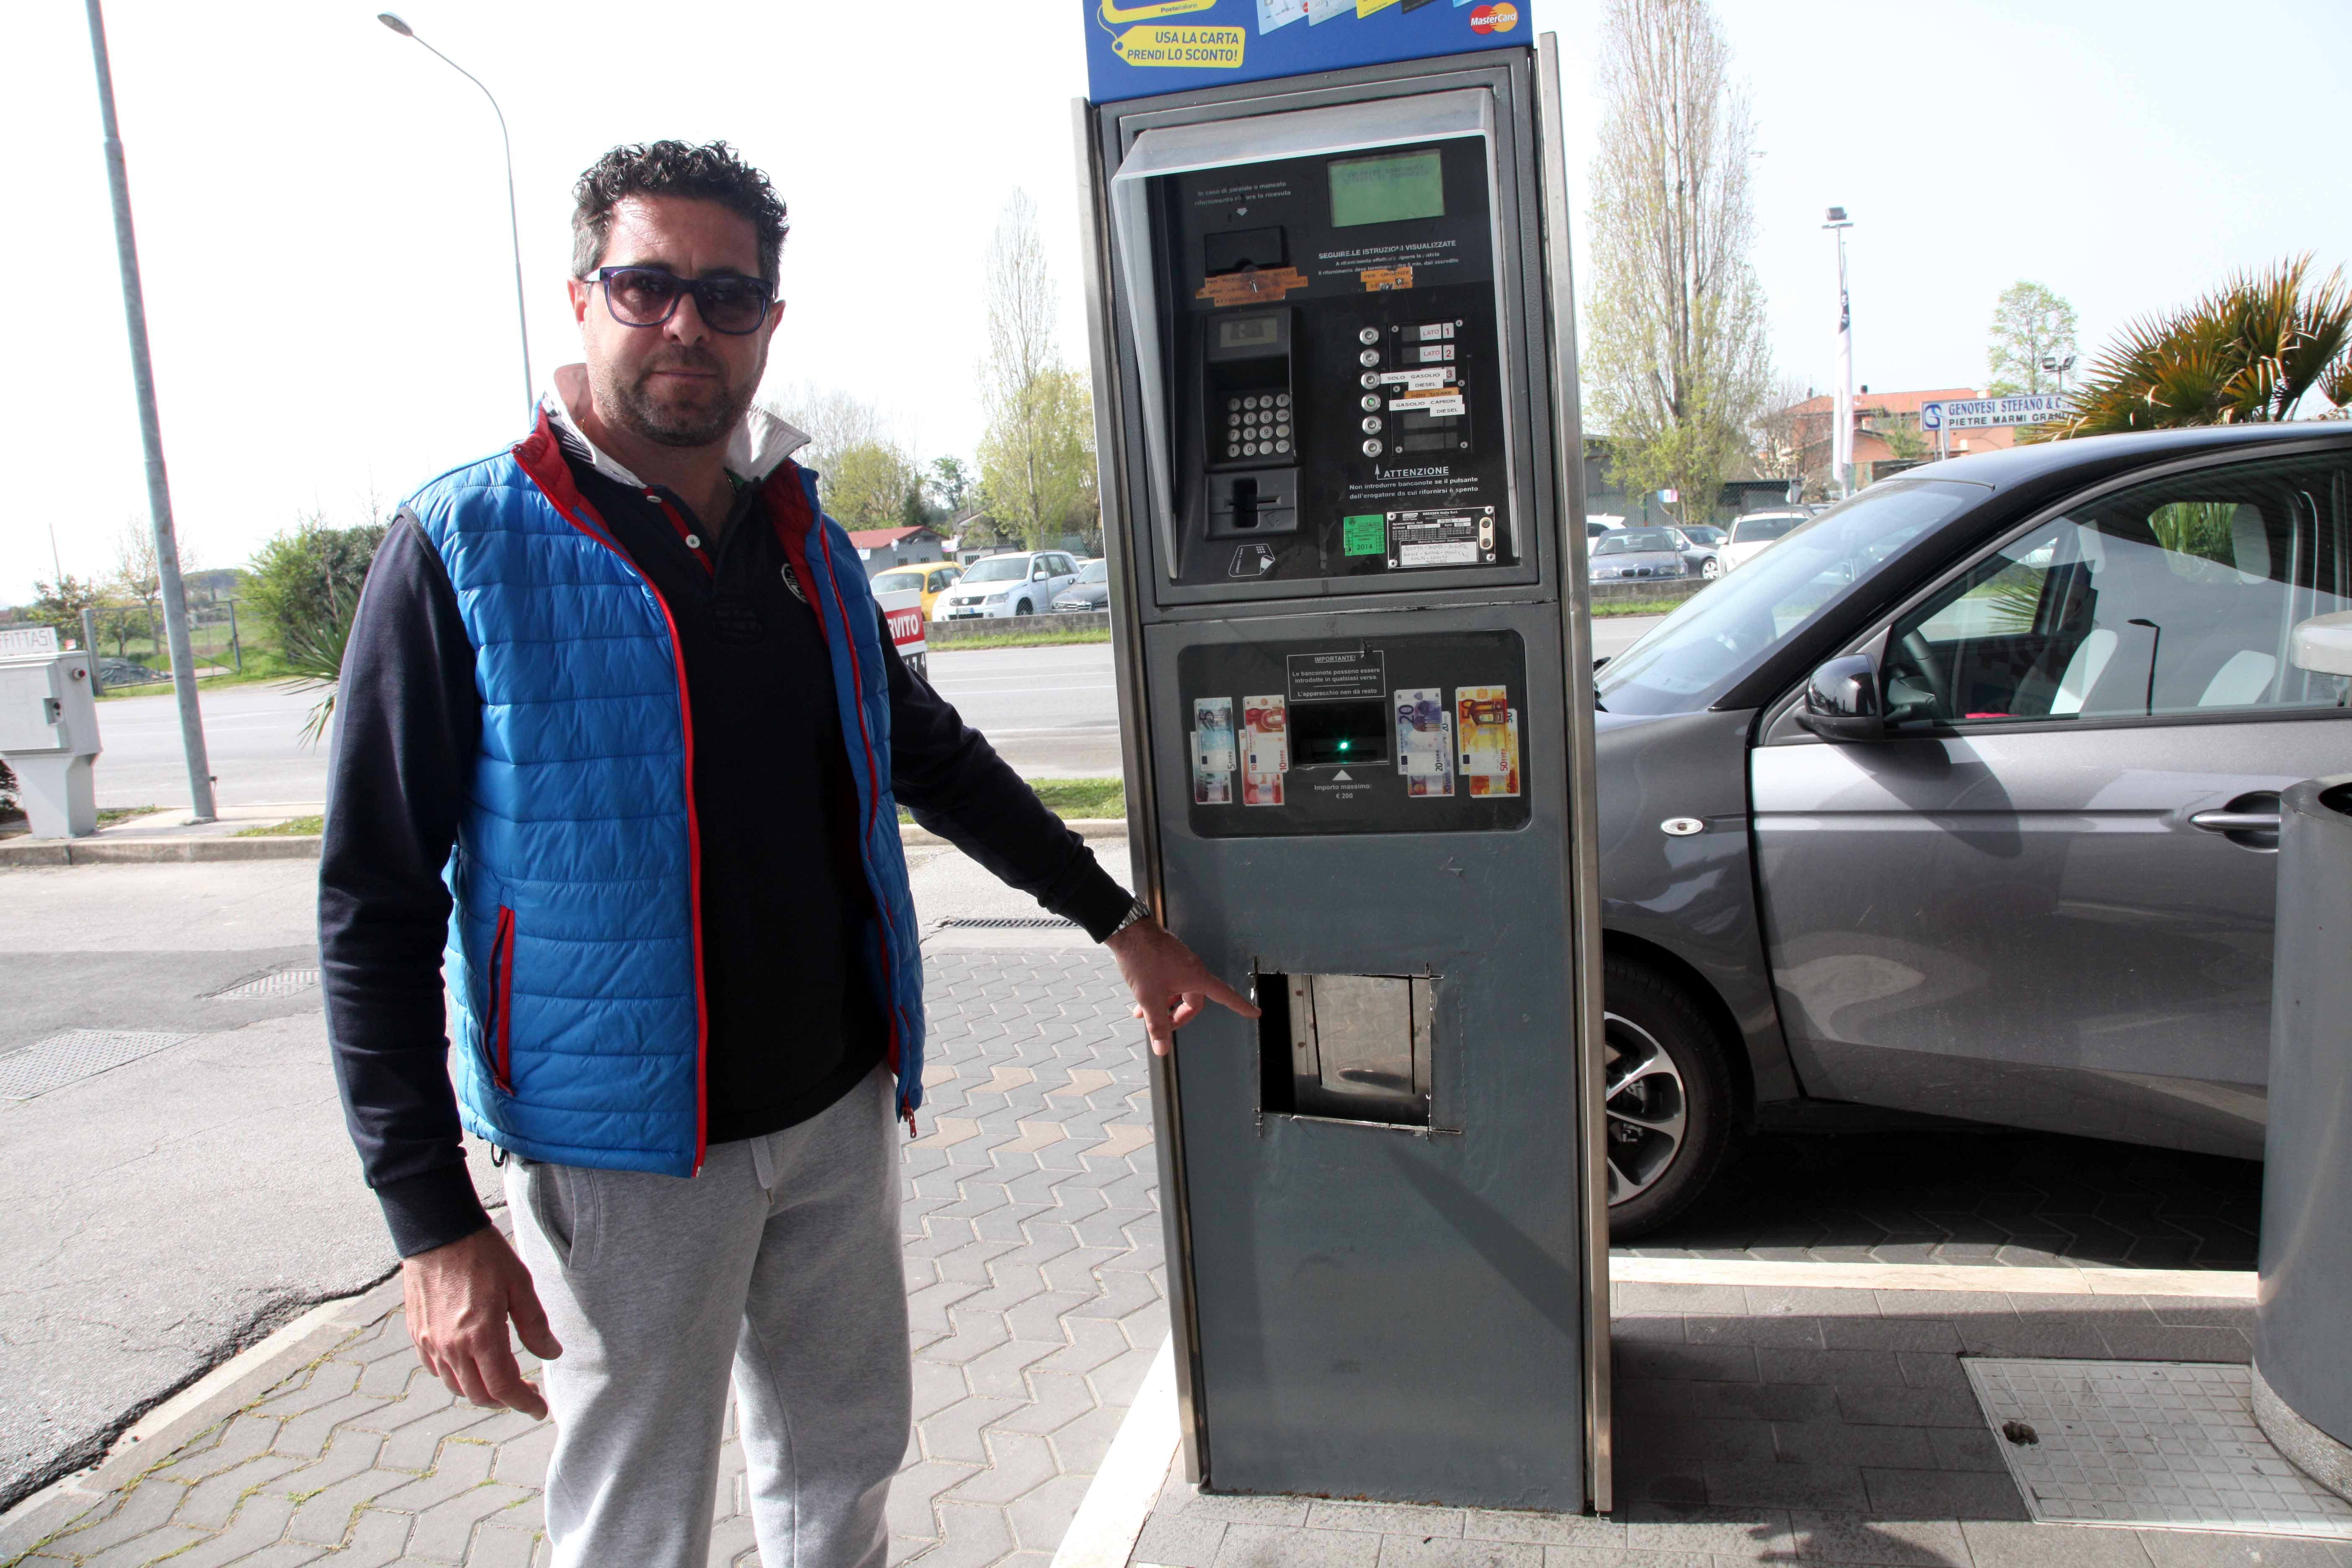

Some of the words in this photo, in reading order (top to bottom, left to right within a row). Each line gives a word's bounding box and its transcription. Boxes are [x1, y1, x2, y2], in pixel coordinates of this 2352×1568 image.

[1470, 12, 1517, 26] MasterCard
[1155, 31, 1179, 44] USA
[1182, 32, 1197, 44] LA
[1200, 32, 1239, 44] CARTA
[1127, 49, 1164, 60] PRENDI
[1168, 49, 1182, 60] LO
[1185, 49, 1237, 61] SCONTO!
[1194, 197, 1233, 206] rifornimento
[1362, 245, 1403, 255] ISTRUZIONI
[1405, 240, 1456, 250] VISUALIZZATE
[1949, 401, 1995, 415] GENOVESI
[2001, 397, 2043, 413] STEFANO
[2046, 397, 2052, 409] &
[1949, 417, 1987, 426] PIETRE
[1993, 414, 2026, 424] MARMI
[1384, 467, 1449, 478] ATTENZIONE
[1449, 477, 1478, 485] pulsante
[1349, 491, 1395, 500] dell'erogatore
[1279, 762, 1287, 771] 10
[1435, 763, 1443, 772] 20
[1500, 761, 1508, 771] 50
